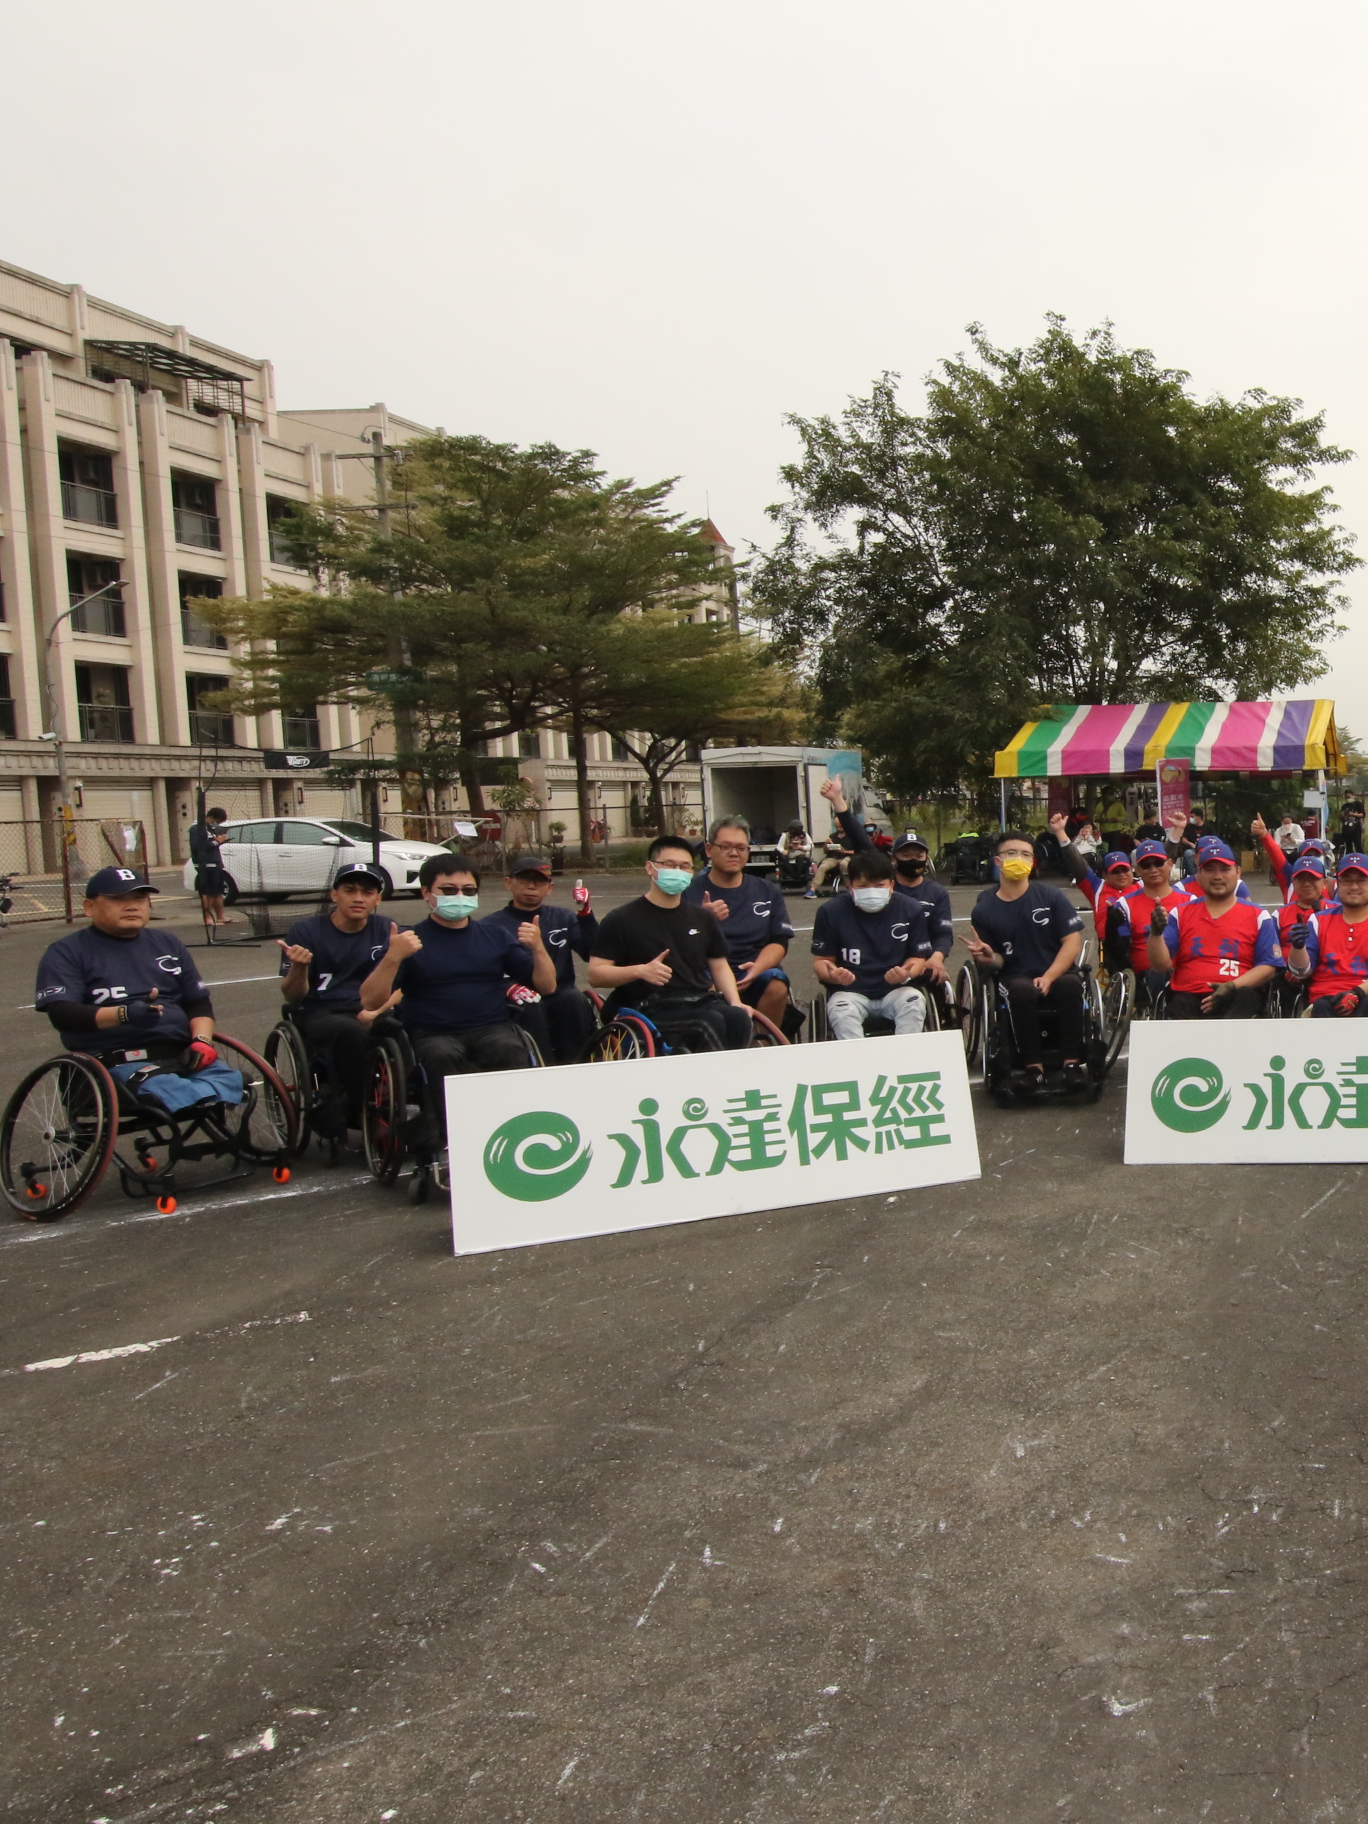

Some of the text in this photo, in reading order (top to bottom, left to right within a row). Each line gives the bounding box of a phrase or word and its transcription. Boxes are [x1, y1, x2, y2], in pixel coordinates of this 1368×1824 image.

[907, 833, 917, 841] B
[353, 863, 368, 871] B
[117, 869, 136, 881] B
[1003, 941, 1013, 955] 2
[841, 948, 861, 965] 18
[1219, 959, 1240, 977] 25
[317, 973, 333, 991] 7
[606, 1071, 951, 1188] 永達保經
